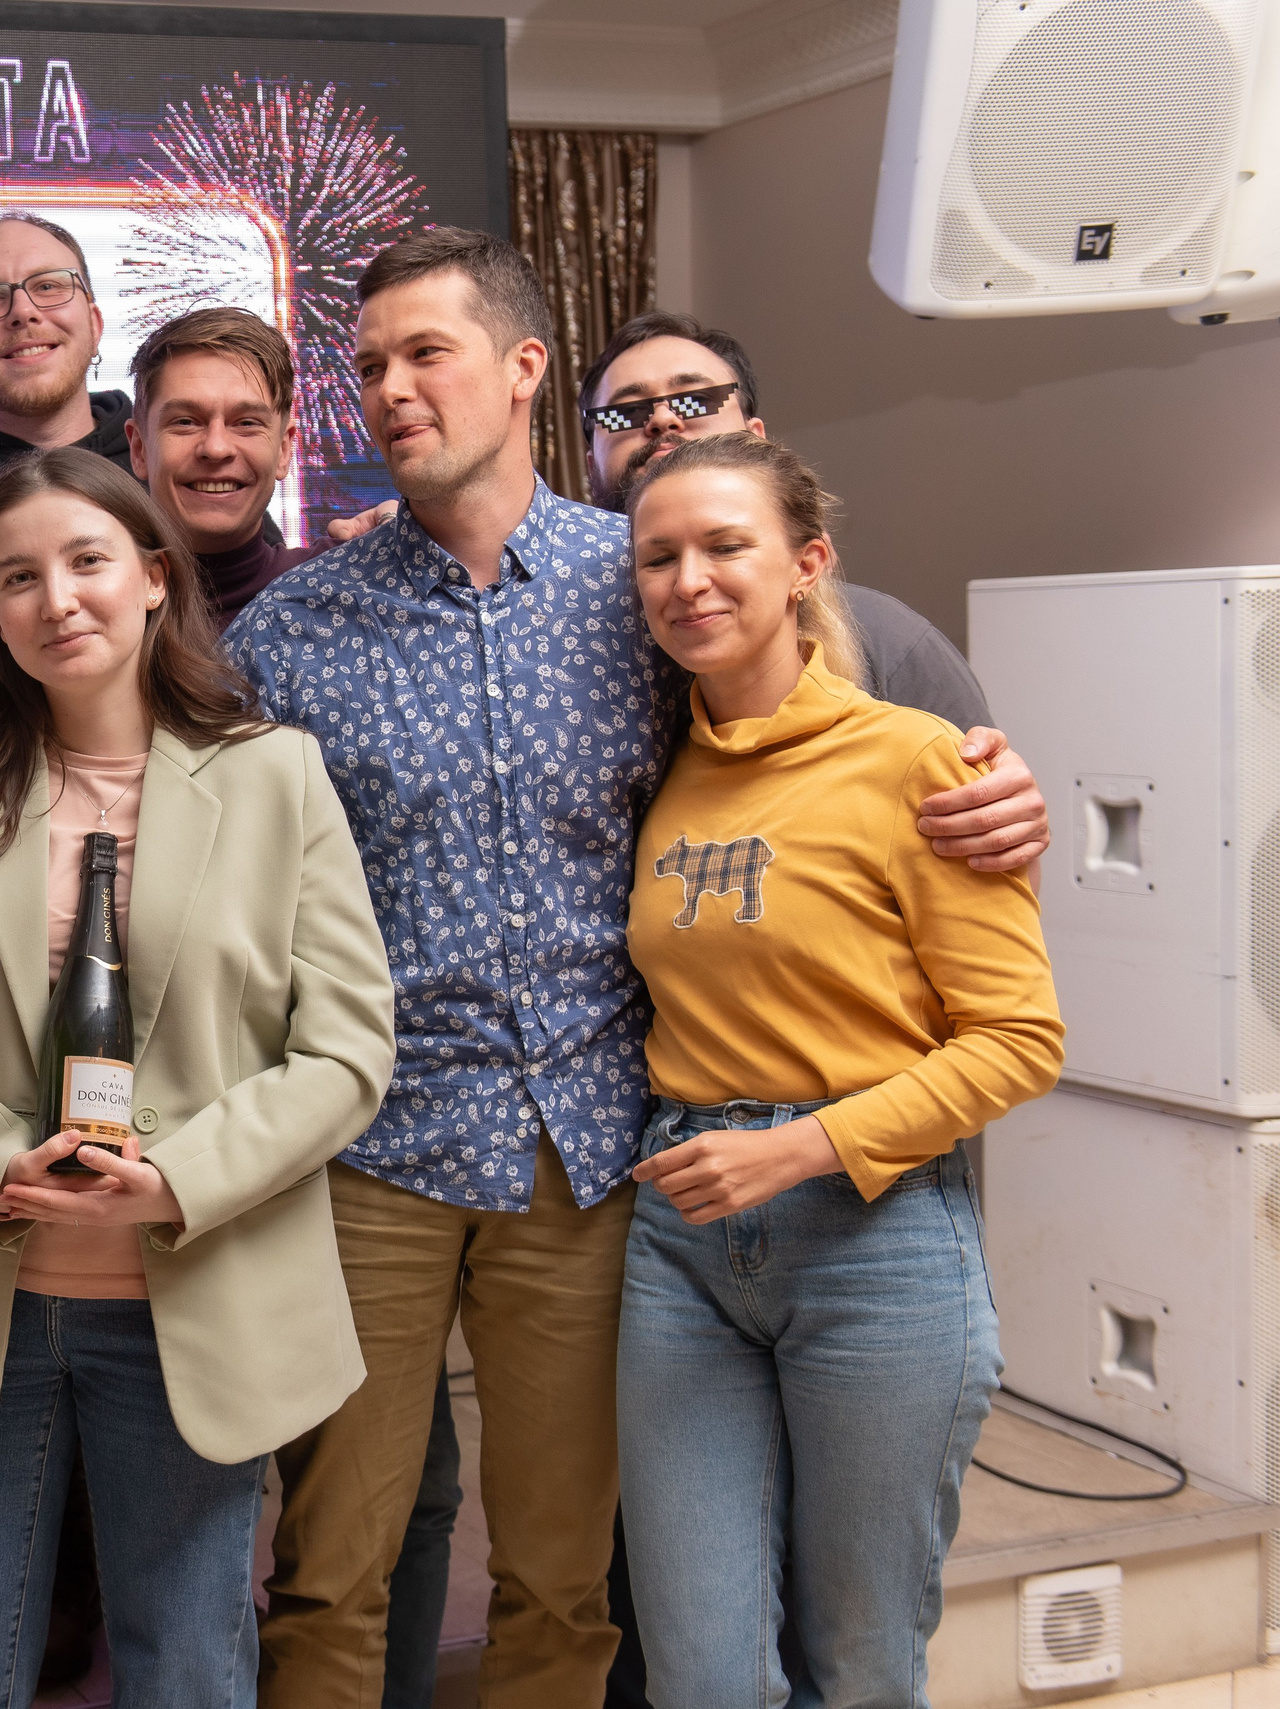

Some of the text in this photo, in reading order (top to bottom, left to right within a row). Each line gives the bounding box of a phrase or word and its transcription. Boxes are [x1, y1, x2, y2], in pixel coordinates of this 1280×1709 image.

[104, 920, 112, 943] DON
[101, 1081, 124, 1091] CAVA
[77, 1089, 107, 1102] DON
